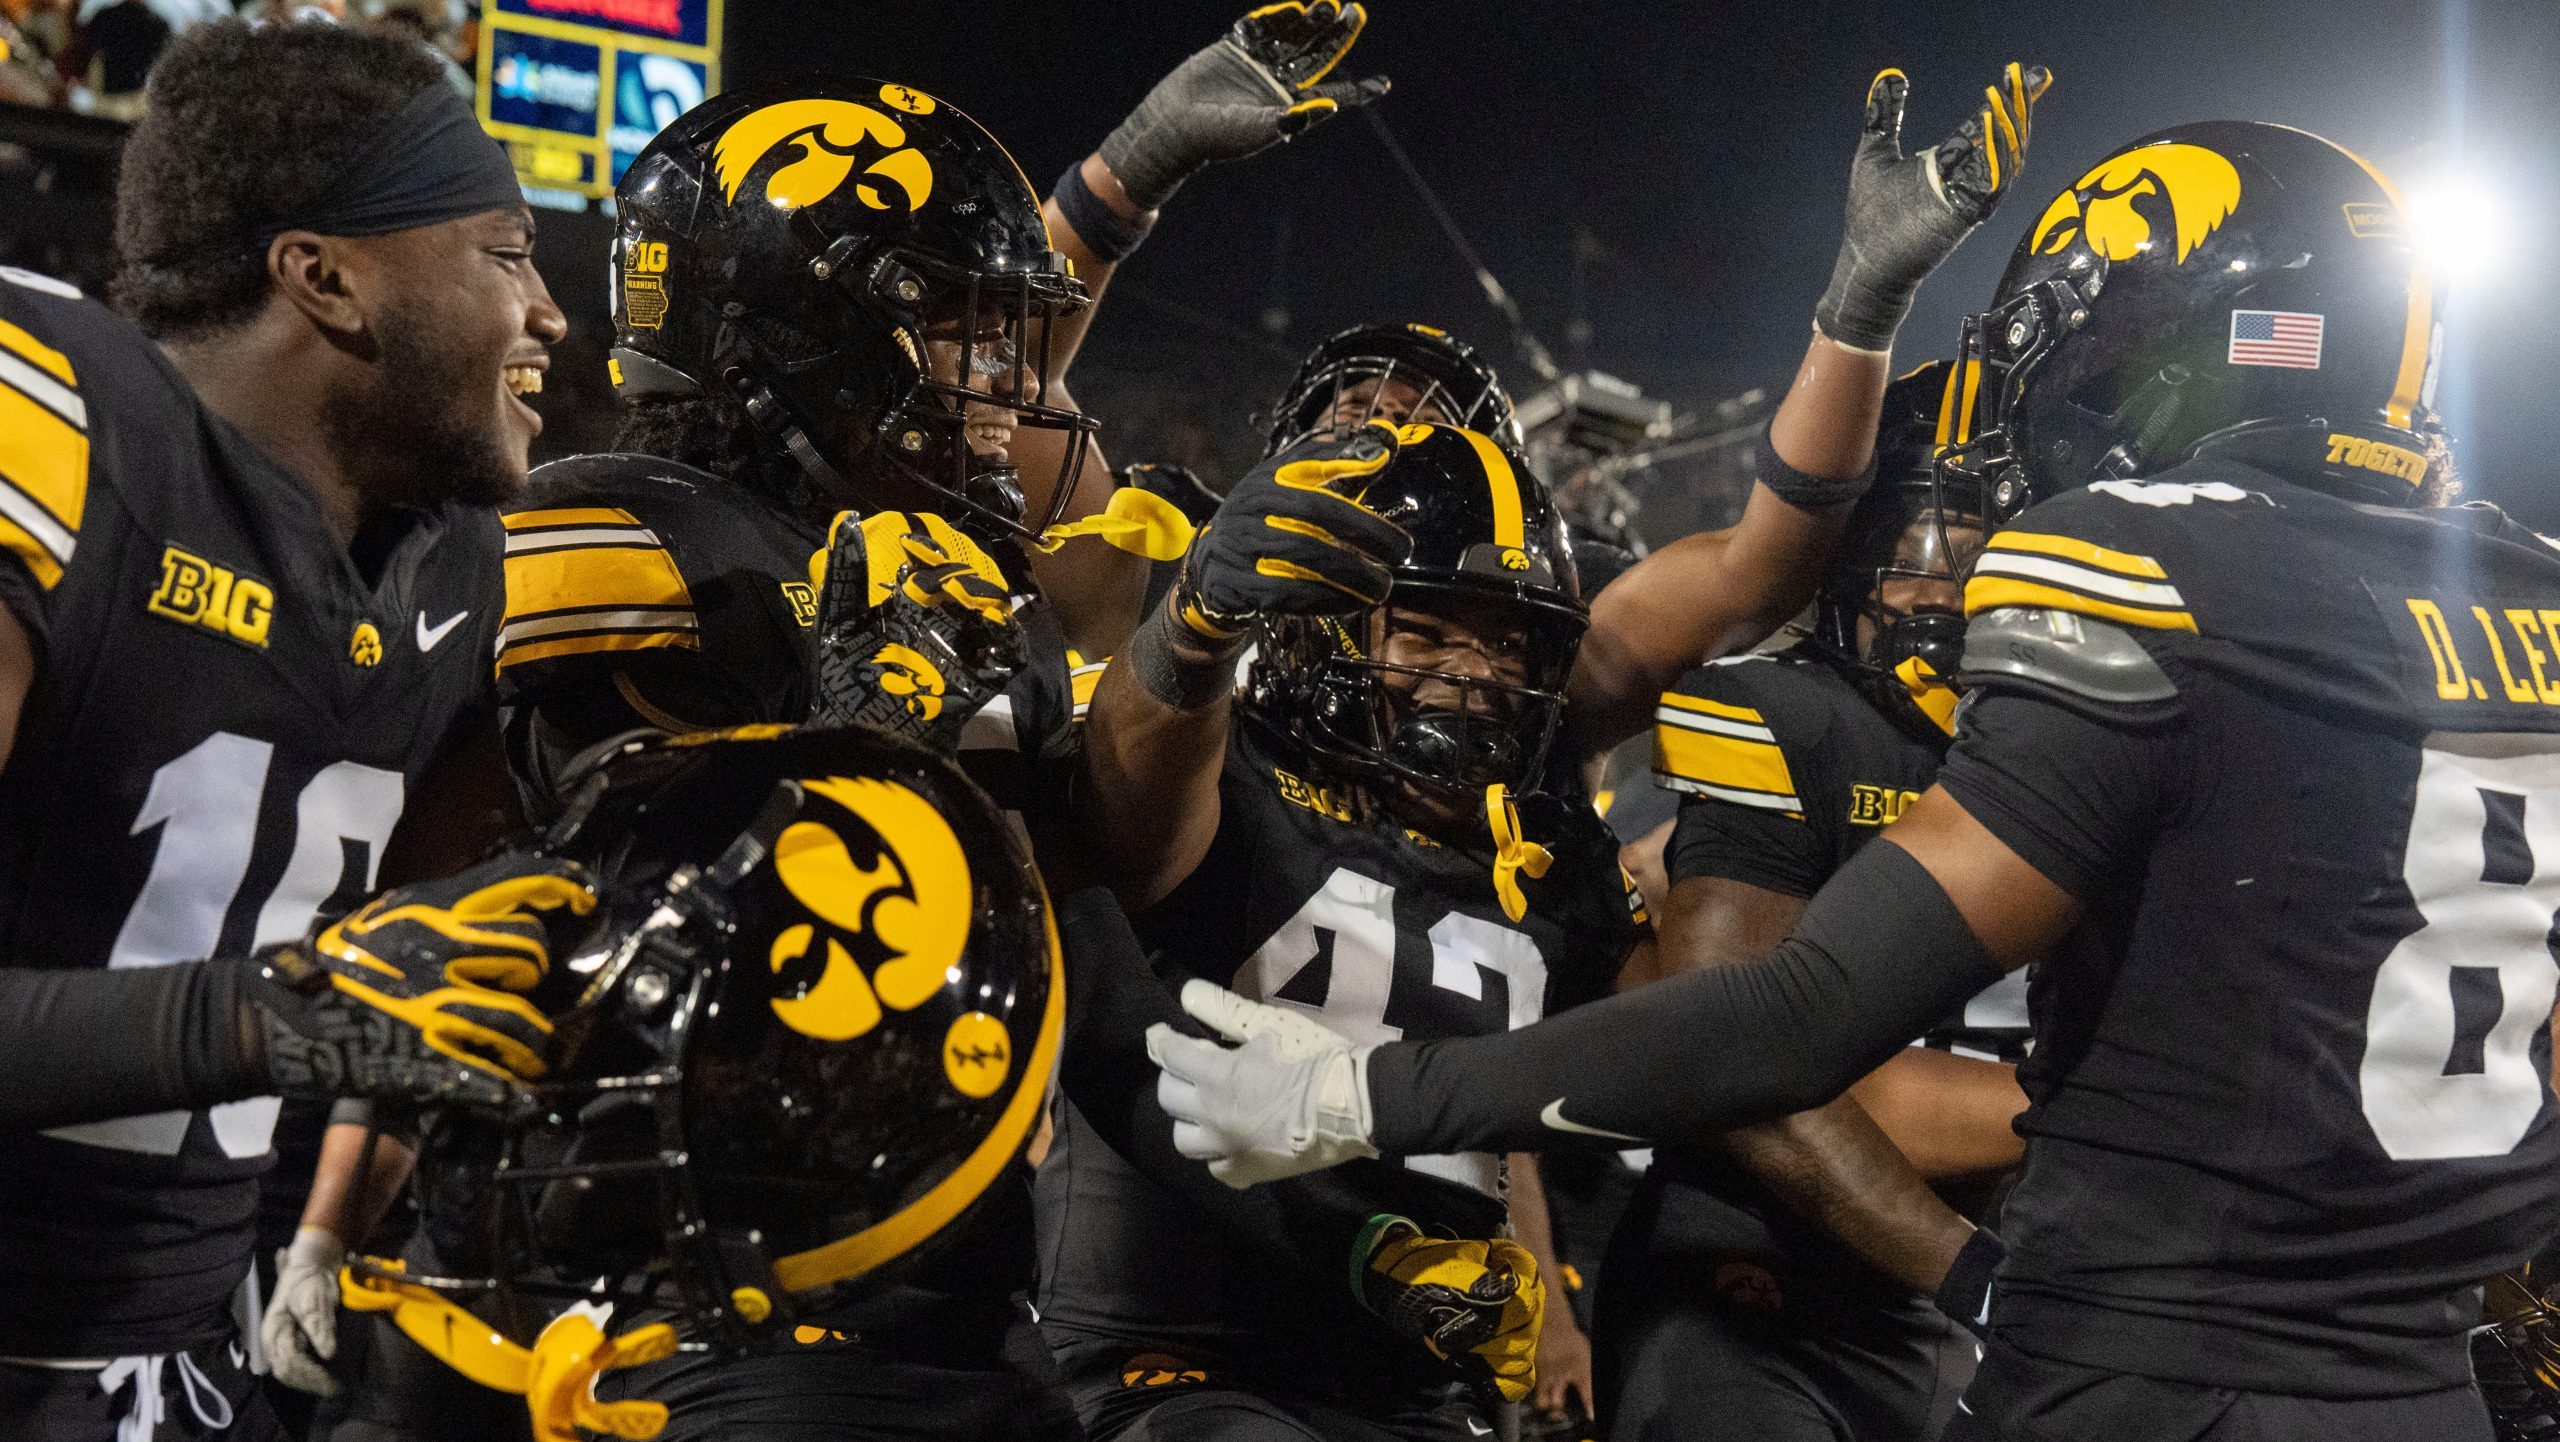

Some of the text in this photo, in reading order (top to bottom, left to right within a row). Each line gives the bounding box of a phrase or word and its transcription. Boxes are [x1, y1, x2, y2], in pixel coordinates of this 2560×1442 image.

[2405, 598, 2560, 706] D. LE
[2360, 731, 2560, 1161] 8
